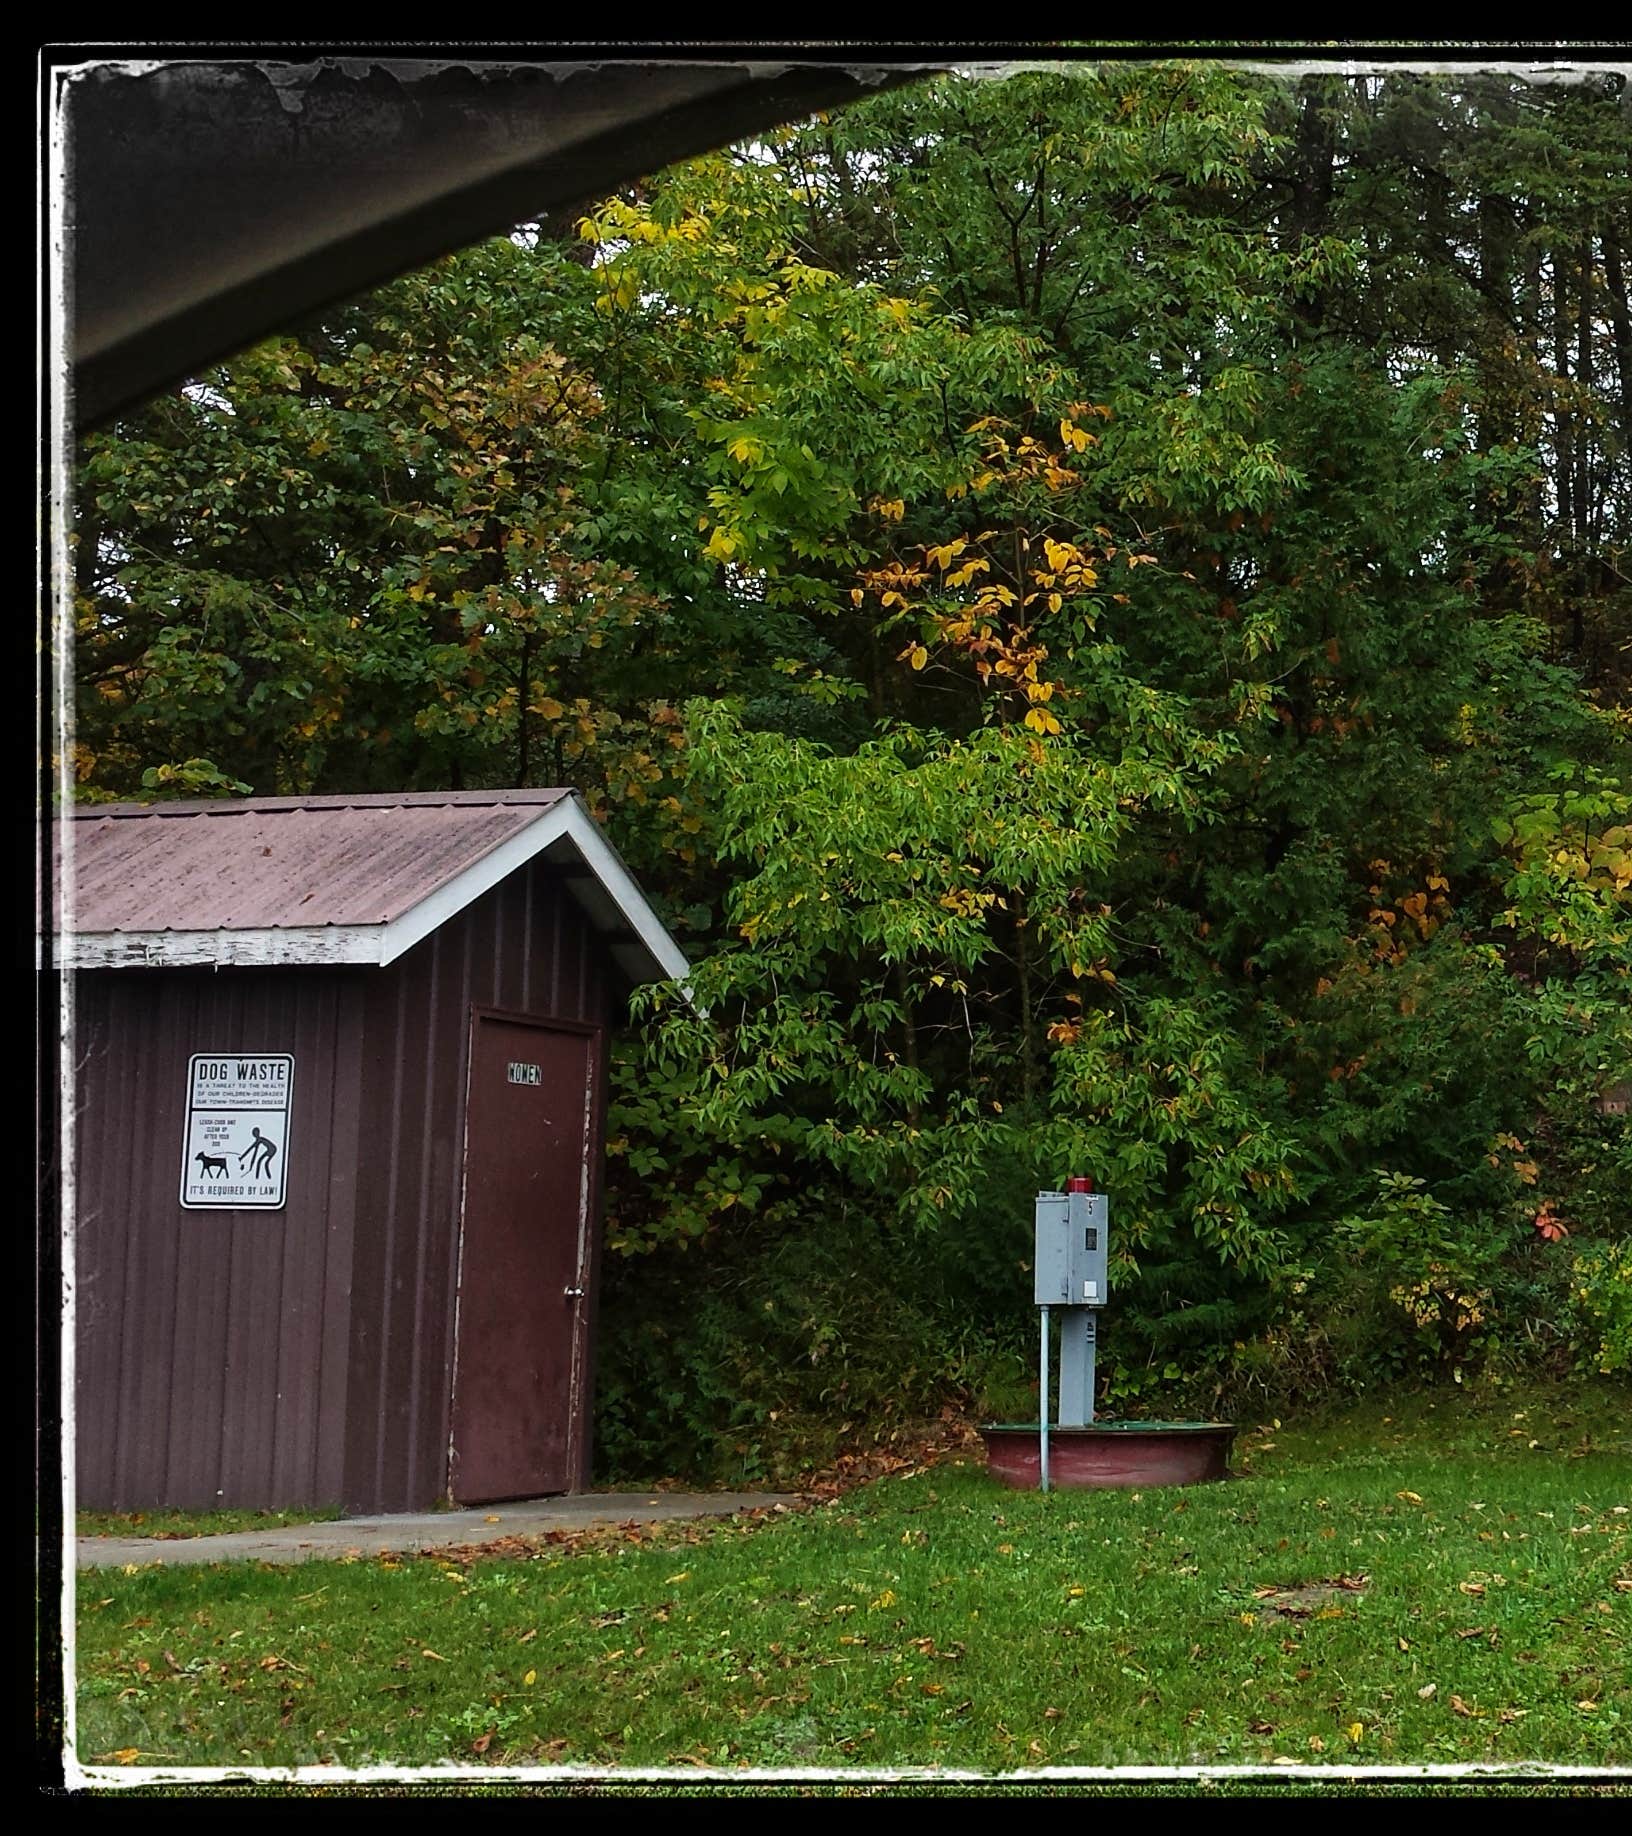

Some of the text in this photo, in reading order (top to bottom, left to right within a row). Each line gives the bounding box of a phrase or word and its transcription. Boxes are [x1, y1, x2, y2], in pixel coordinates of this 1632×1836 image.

[199, 1063, 286, 1081] DOG WASTE
[510, 1063, 542, 1084] WOMEN
[190, 1185, 279, 1196] IT'S REQUIRED BY LAW!
